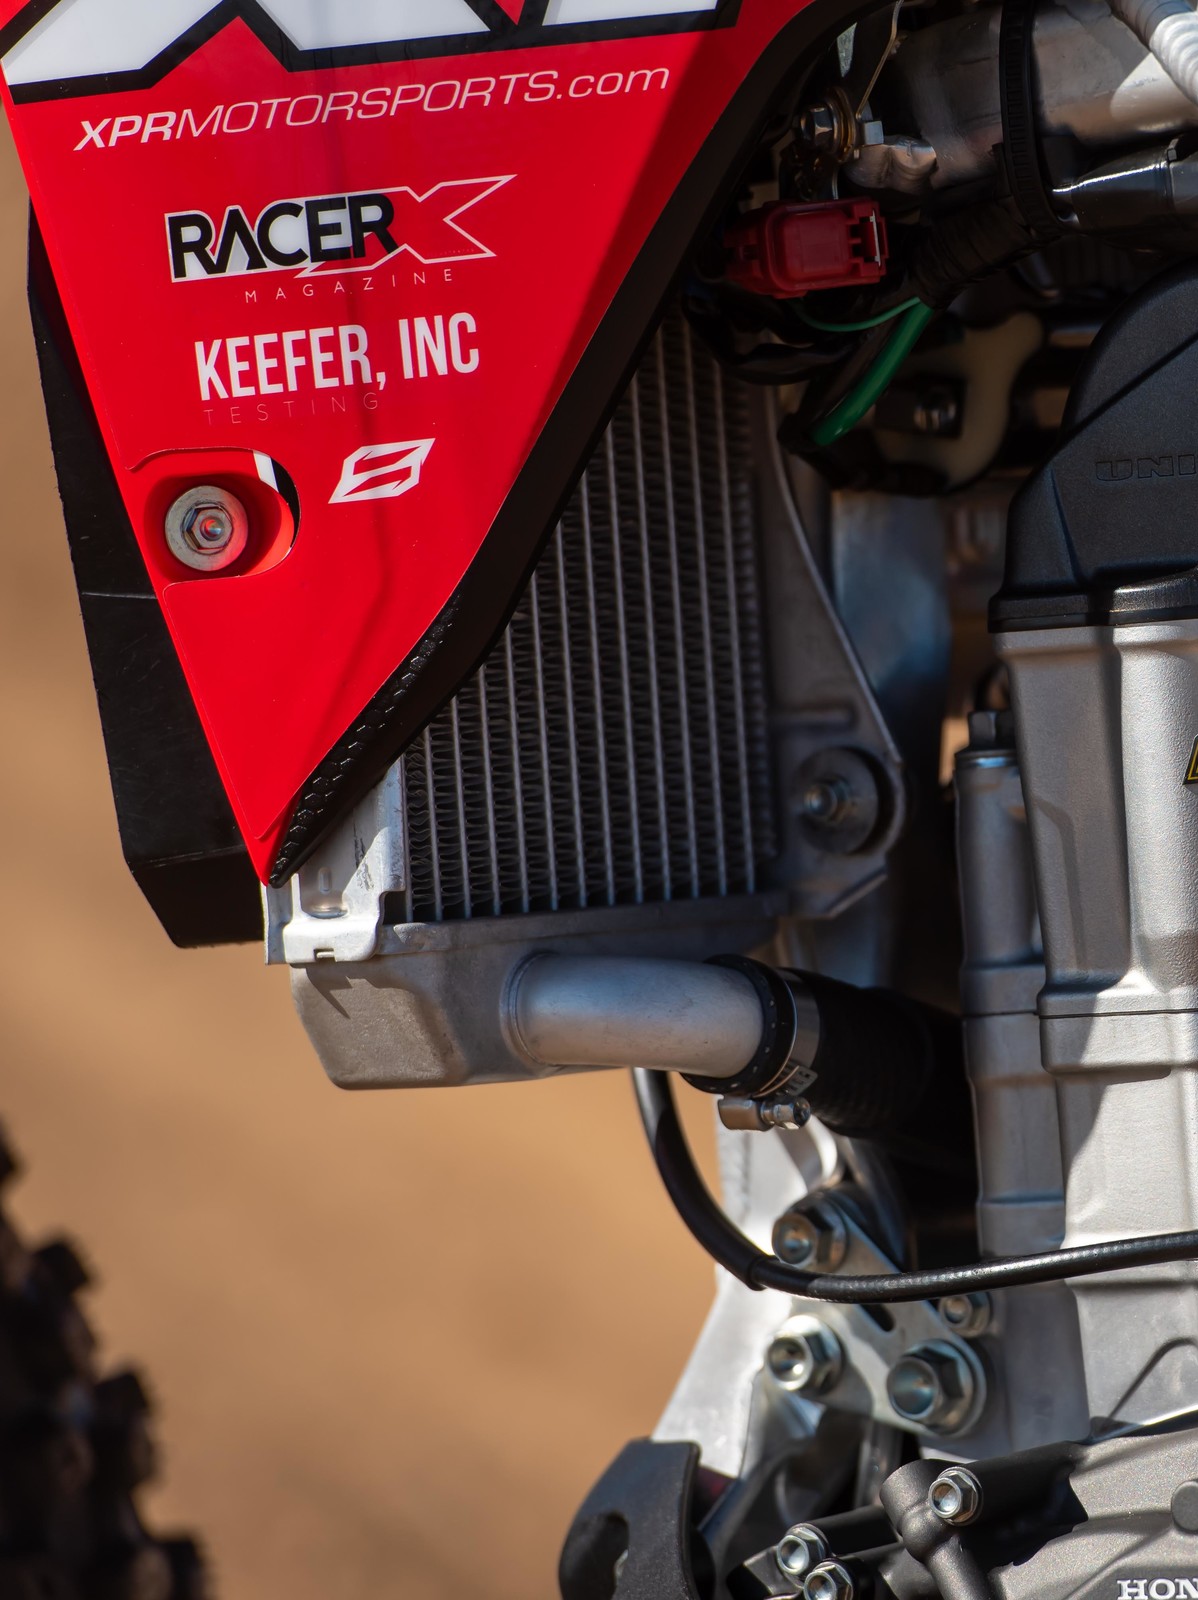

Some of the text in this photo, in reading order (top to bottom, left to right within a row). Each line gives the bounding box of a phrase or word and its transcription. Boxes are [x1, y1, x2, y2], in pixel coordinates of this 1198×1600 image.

[73, 67, 670, 151] XPRMOTORSPORTS.com
[244, 268, 454, 303] MAGAZINE
[195, 312, 480, 401] KEEFER, INC
[203, 392, 379, 426] TESTING
